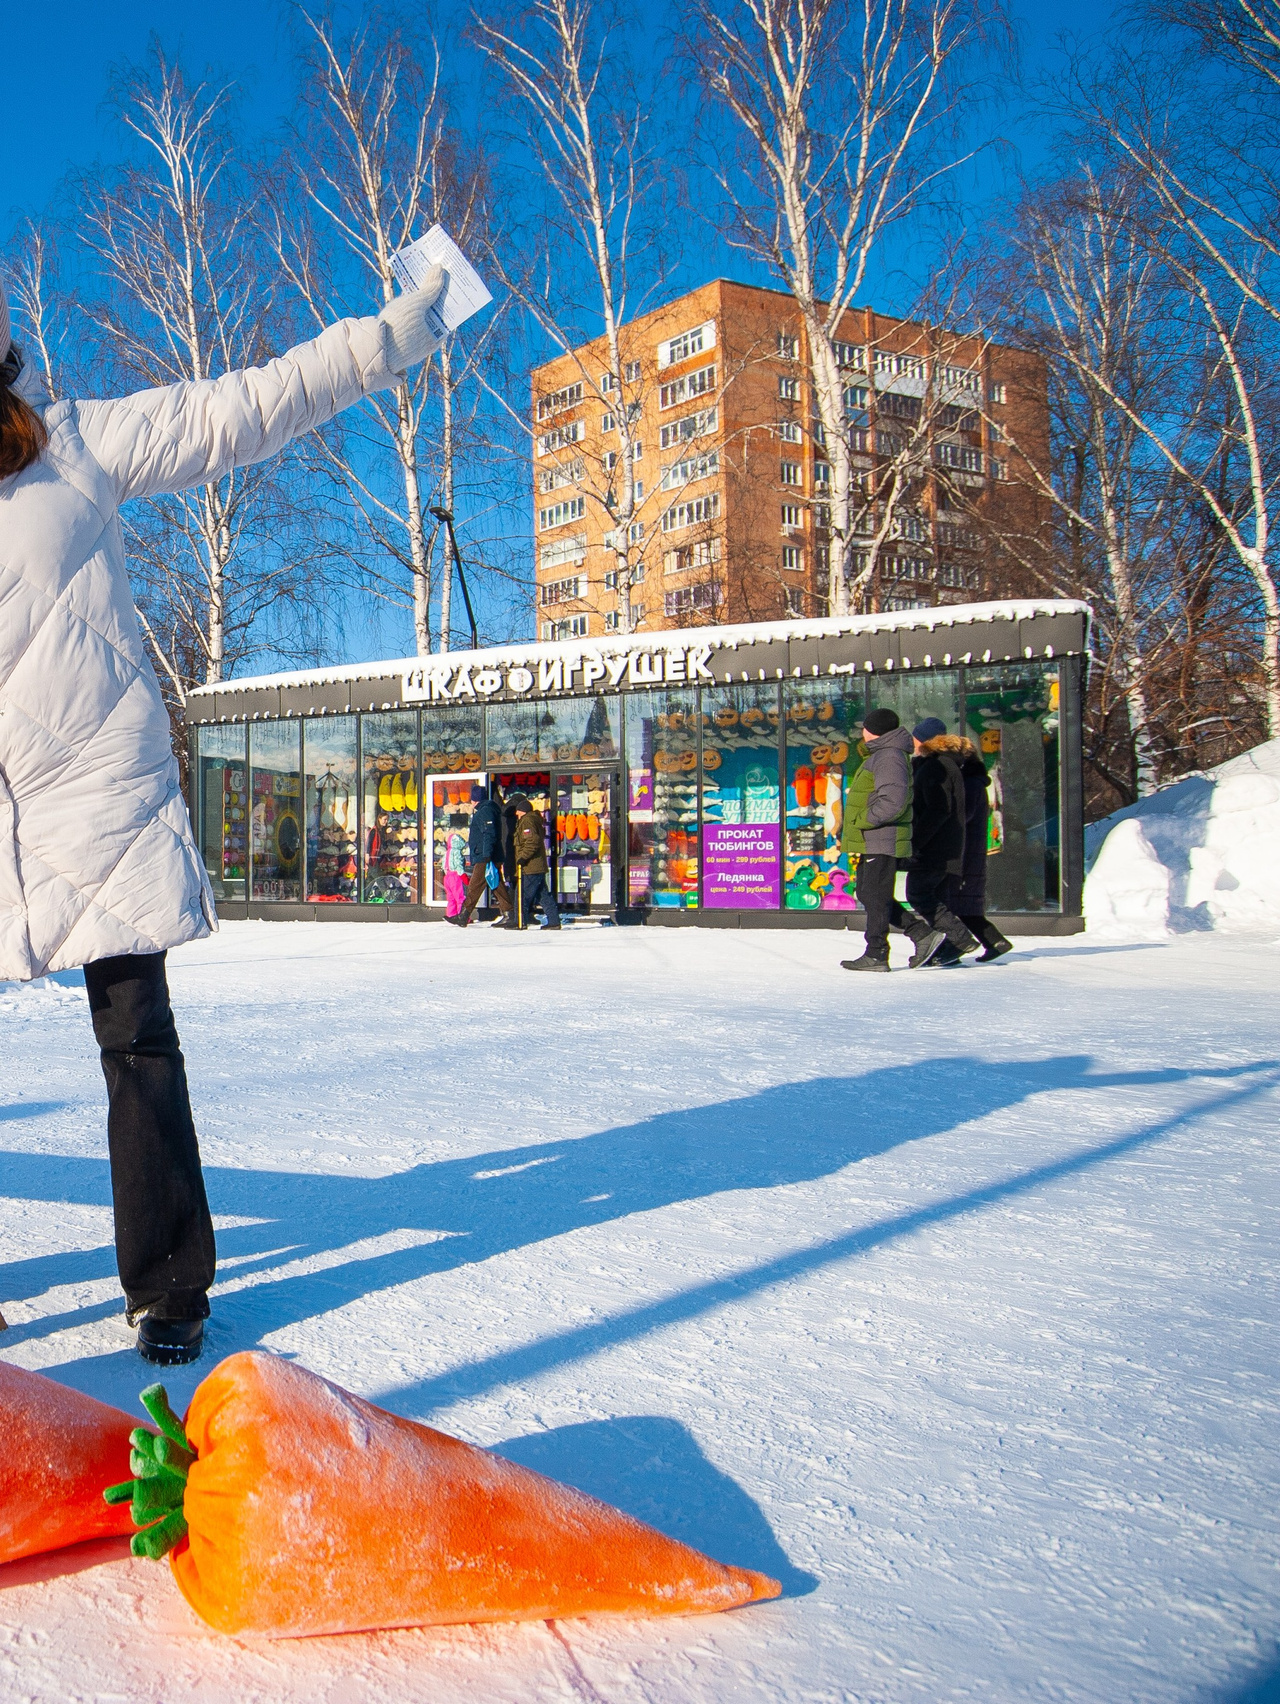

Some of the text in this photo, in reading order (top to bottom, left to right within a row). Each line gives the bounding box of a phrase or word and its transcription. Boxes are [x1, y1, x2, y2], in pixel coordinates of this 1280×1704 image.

[402, 647, 713, 702] ШКАФ ИГРУШЕК
[718, 829, 764, 839] ПРОКАТ
[708, 841, 774, 851] ТЮБИНГОВ
[749, 856, 776, 864] рублей
[717, 873, 765, 883] Ледянка
[746, 886, 773, 894] рублей
